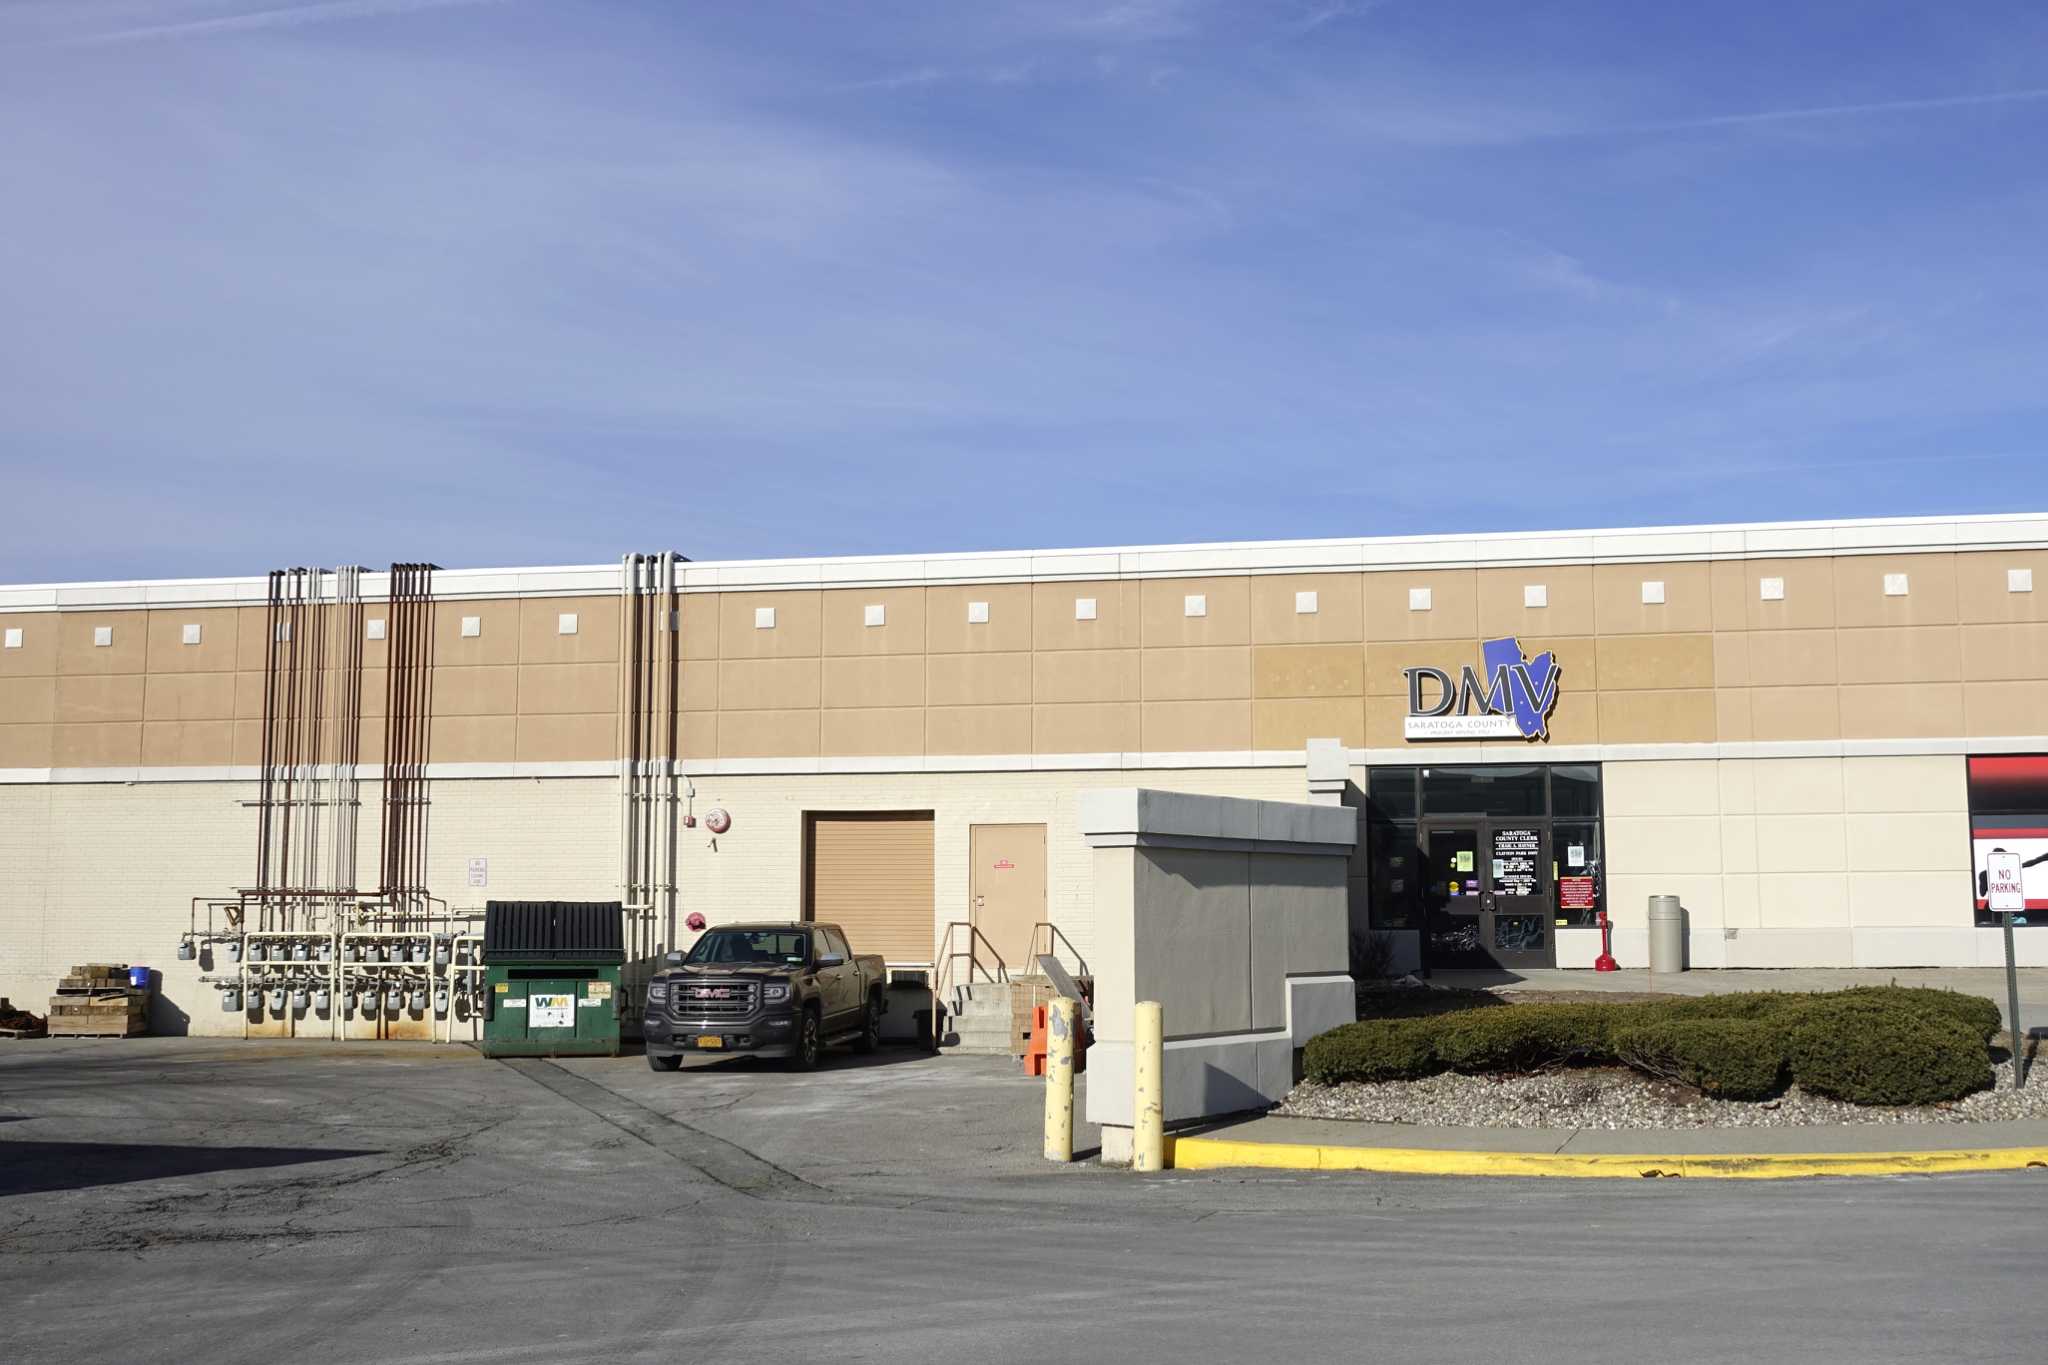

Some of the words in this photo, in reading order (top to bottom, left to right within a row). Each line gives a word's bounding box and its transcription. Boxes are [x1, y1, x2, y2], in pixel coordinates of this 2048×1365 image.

[1402, 664, 1559, 716] DMV
[1408, 720, 1463, 729] SARATOGA
[1468, 719, 1511, 728] COUNTY
[1998, 869, 2011, 880] NO
[1991, 882, 2021, 893] PARKING
[694, 987, 731, 998] GMC
[535, 997, 568, 1007] WM
